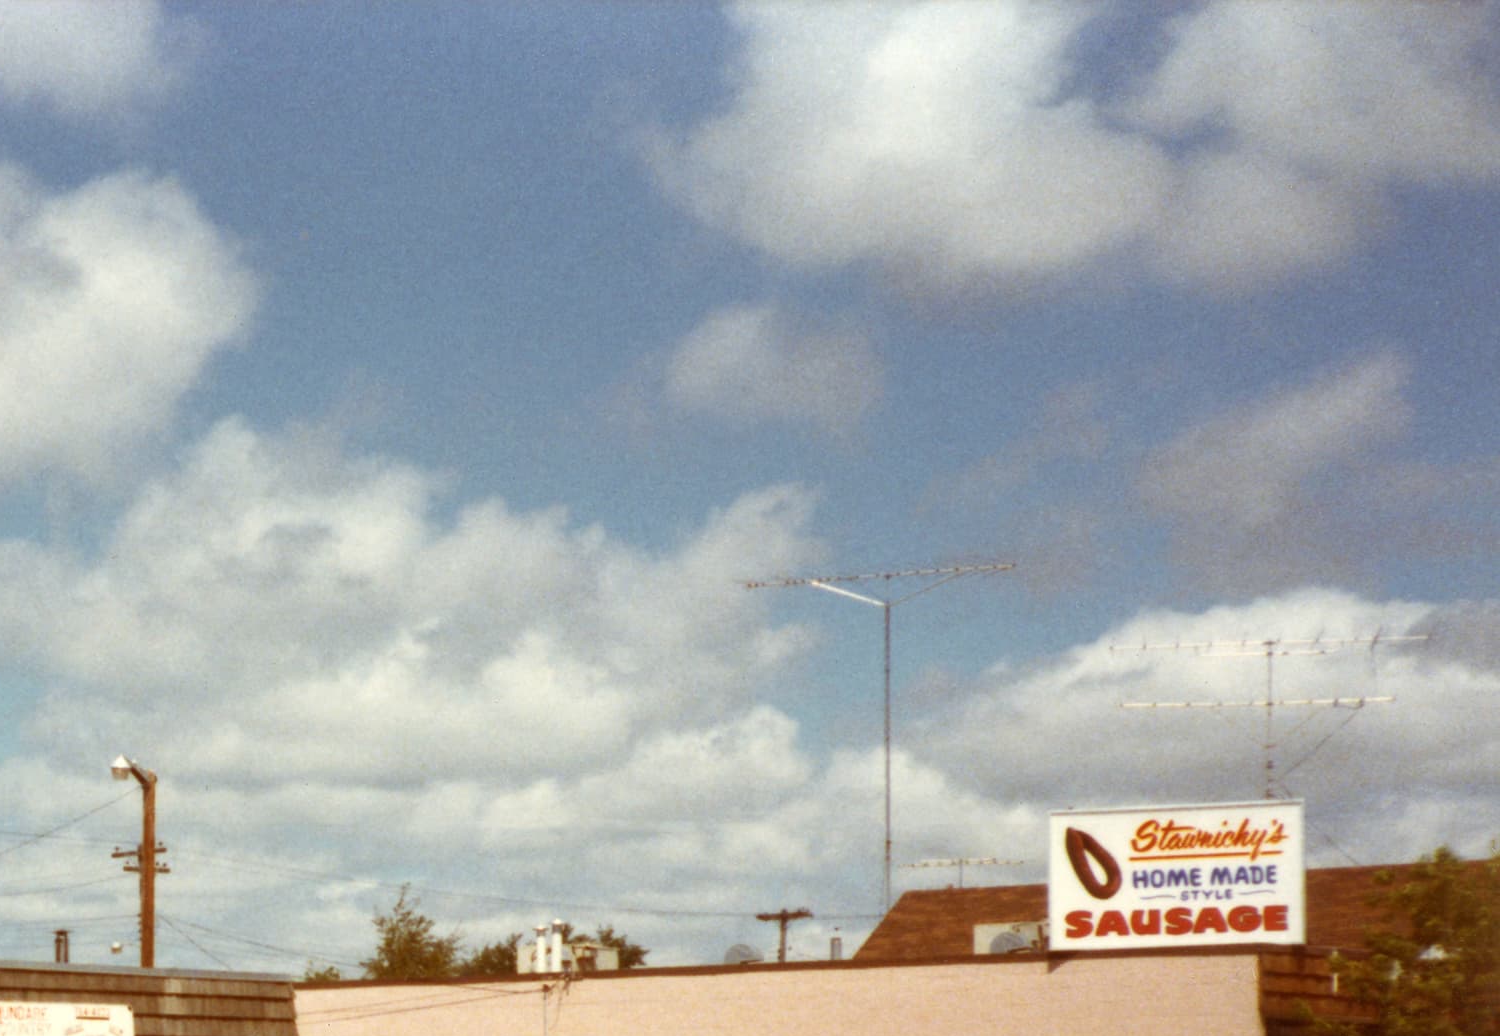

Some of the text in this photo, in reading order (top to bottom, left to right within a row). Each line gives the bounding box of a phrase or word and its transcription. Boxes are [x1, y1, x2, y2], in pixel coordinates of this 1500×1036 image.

[1131, 818, 1288, 860] Stawnichy's
[1133, 865, 1277, 888] HOME MADE
[1180, 889, 1233, 901] STYLE
[1064, 905, 1289, 939] SAUSAGE
